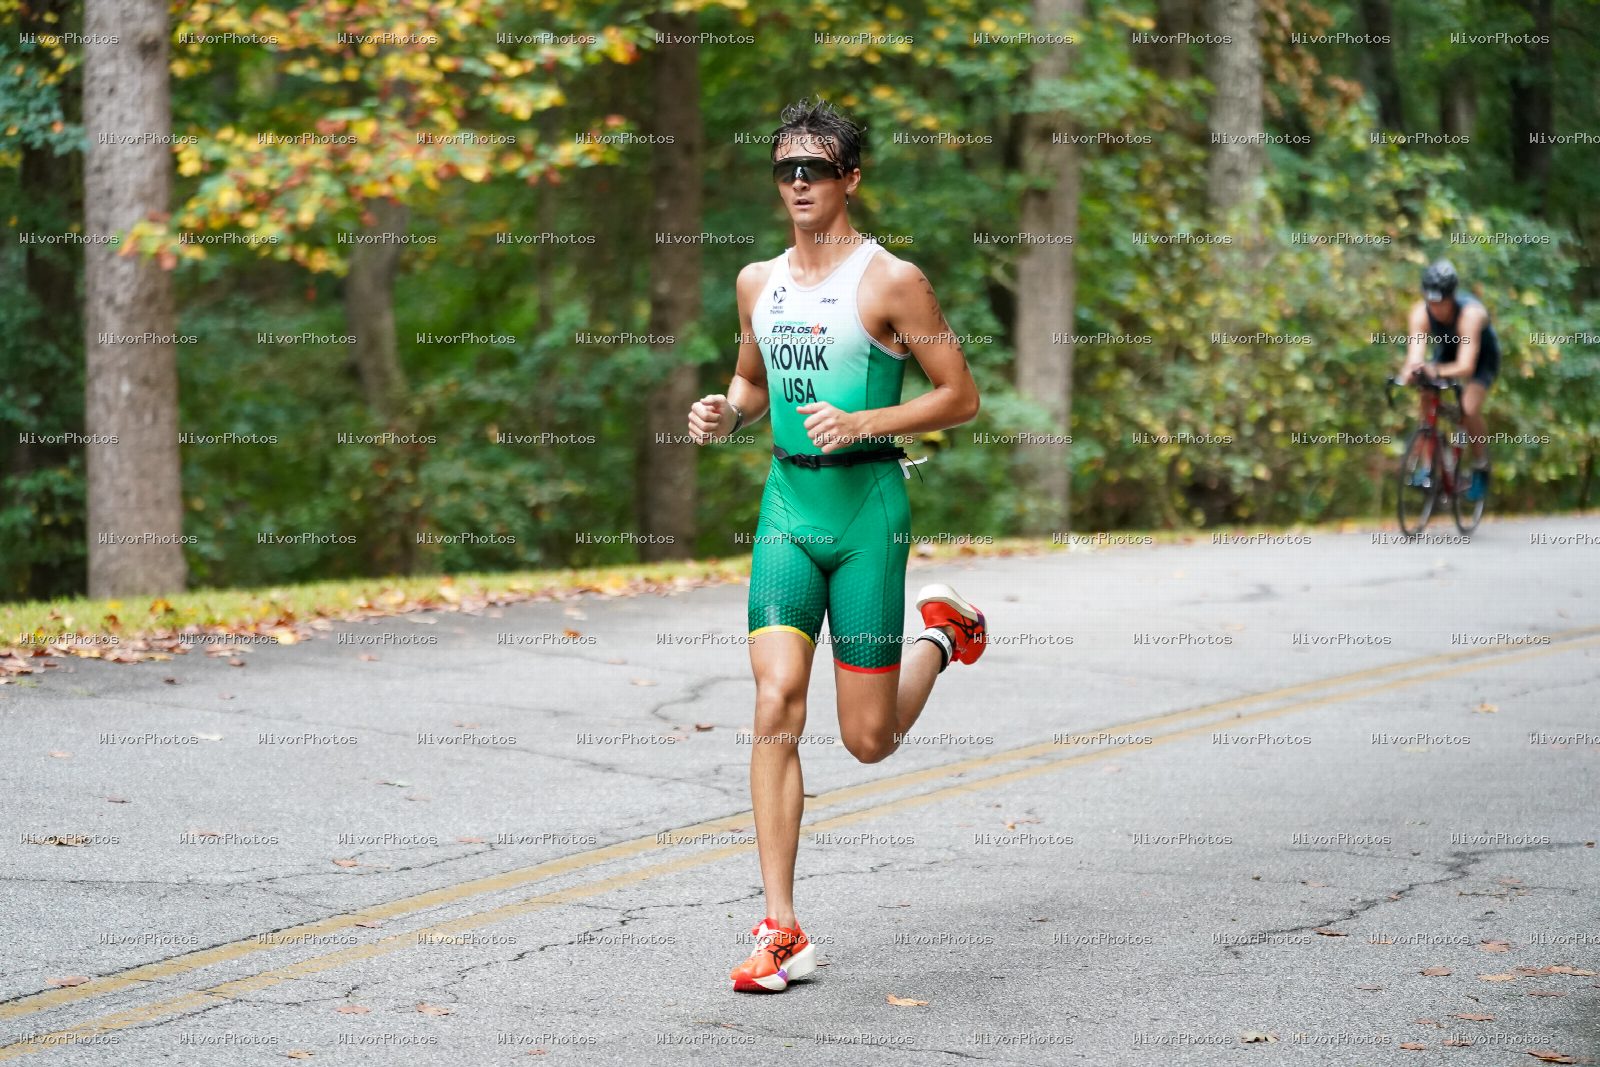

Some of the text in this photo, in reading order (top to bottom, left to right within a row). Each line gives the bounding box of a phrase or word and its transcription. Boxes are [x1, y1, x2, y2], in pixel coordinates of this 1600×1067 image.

[771, 325, 828, 336] EXPLOSION
[770, 344, 829, 371] KOVAK
[782, 377, 818, 404] USA
